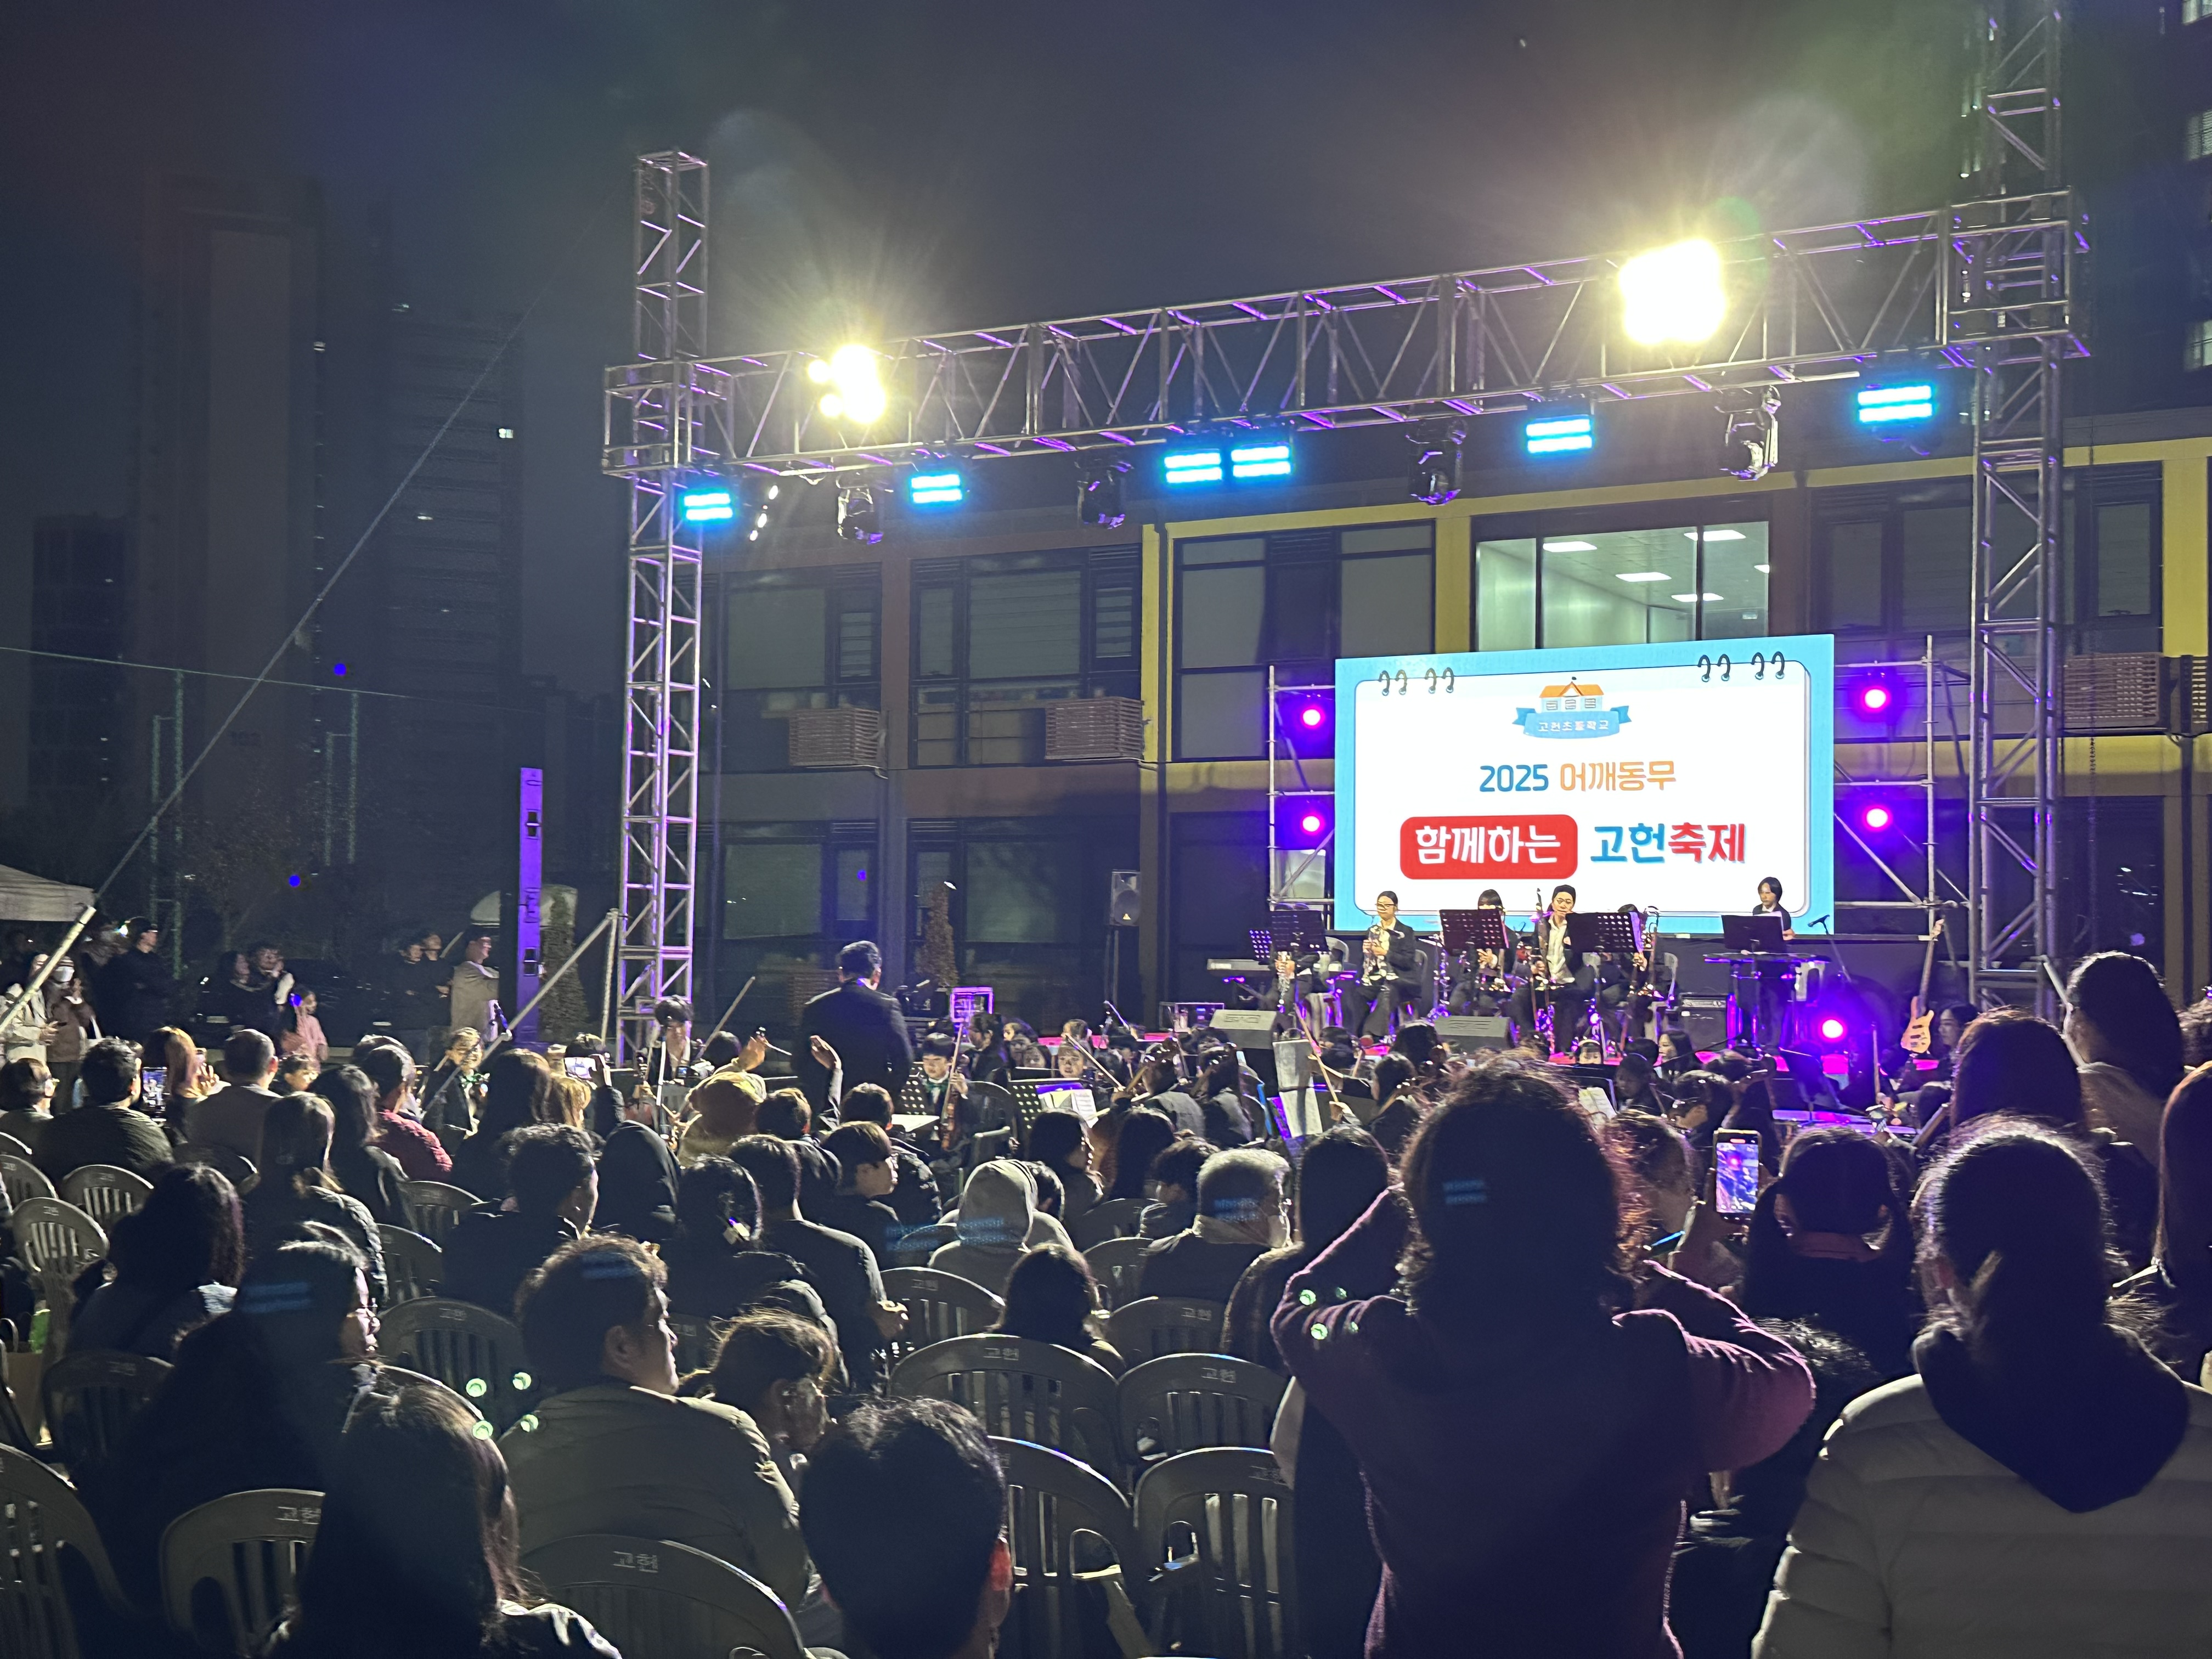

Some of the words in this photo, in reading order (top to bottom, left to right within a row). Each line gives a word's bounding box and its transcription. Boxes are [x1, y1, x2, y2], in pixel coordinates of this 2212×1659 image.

[1480, 764, 1549, 792] 2025
[1560, 760, 1677, 792] 어깨동무
[1415, 825, 1561, 864] 함께하는
[1590, 822, 1746, 864] 고헌축제
[983, 1347, 1020, 1361] 고헌
[613, 1550, 659, 1573] 고헌
